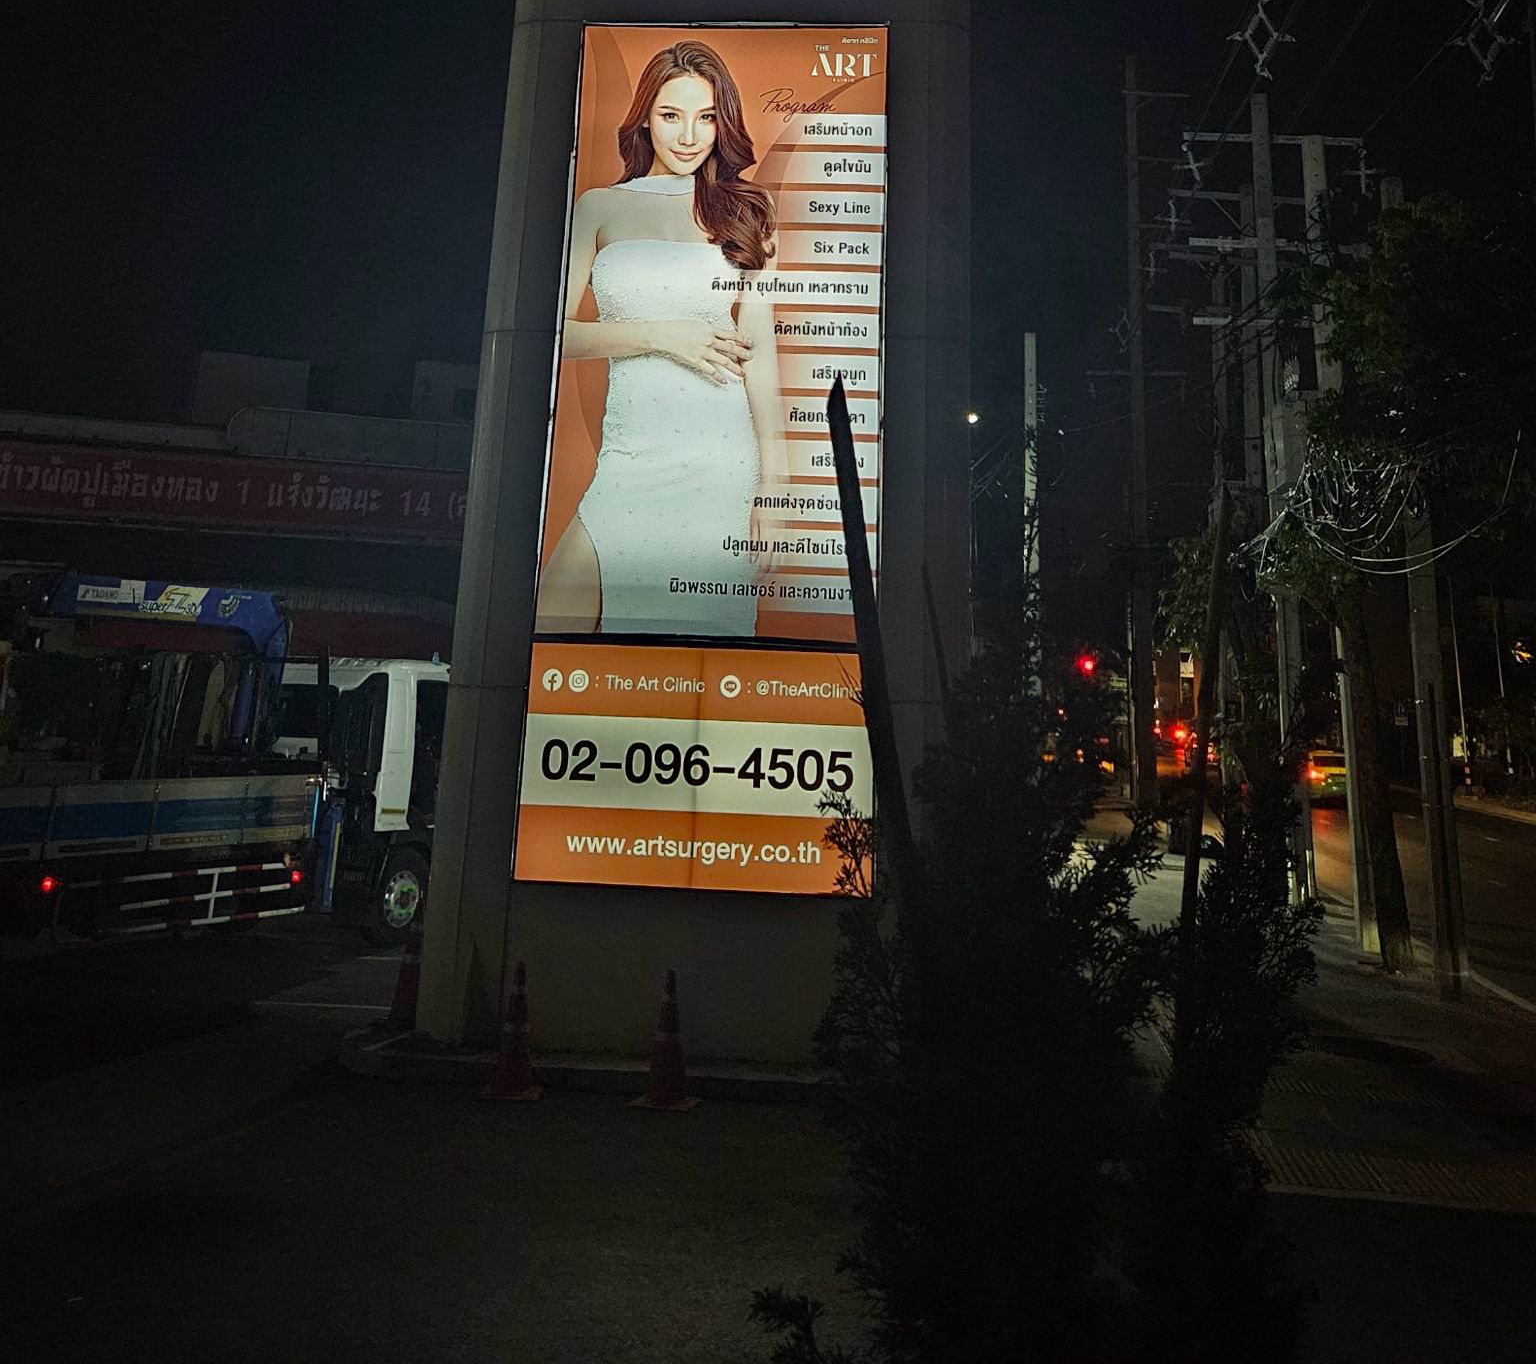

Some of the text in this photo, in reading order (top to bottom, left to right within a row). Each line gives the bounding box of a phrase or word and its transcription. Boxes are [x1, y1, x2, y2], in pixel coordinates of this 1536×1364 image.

[815, 44, 830, 52] THE
[811, 52, 878, 76] ART
[759, 87, 836, 124] Program
[804, 123, 872, 137] เสริมหน้าอก
[823, 158, 872, 178] ดูดไขมัน
[809, 201, 871, 215] Sexy Line
[813, 241, 870, 255] Six Pack
[711, 276, 869, 296] ดึงหน้า ยุบโหนก เหลากราม
[774, 320, 868, 338] ตัดหนังหน้าท้อง
[236, 478, 250, 505] 1
[400, 488, 431, 516] 14
[722, 535, 848, 556] ปลูกผม และดีไซน์ไร
[669, 577, 854, 601] ผิวพรรณ เลเซอร์ และความงา
[604, 674, 633, 691] The
[636, 675, 661, 692] Art
[663, 676, 706, 694] Clinic
[541, 738, 855, 793] 02-096-4505
[566, 835, 821, 865] www.artsurgery.co.th
